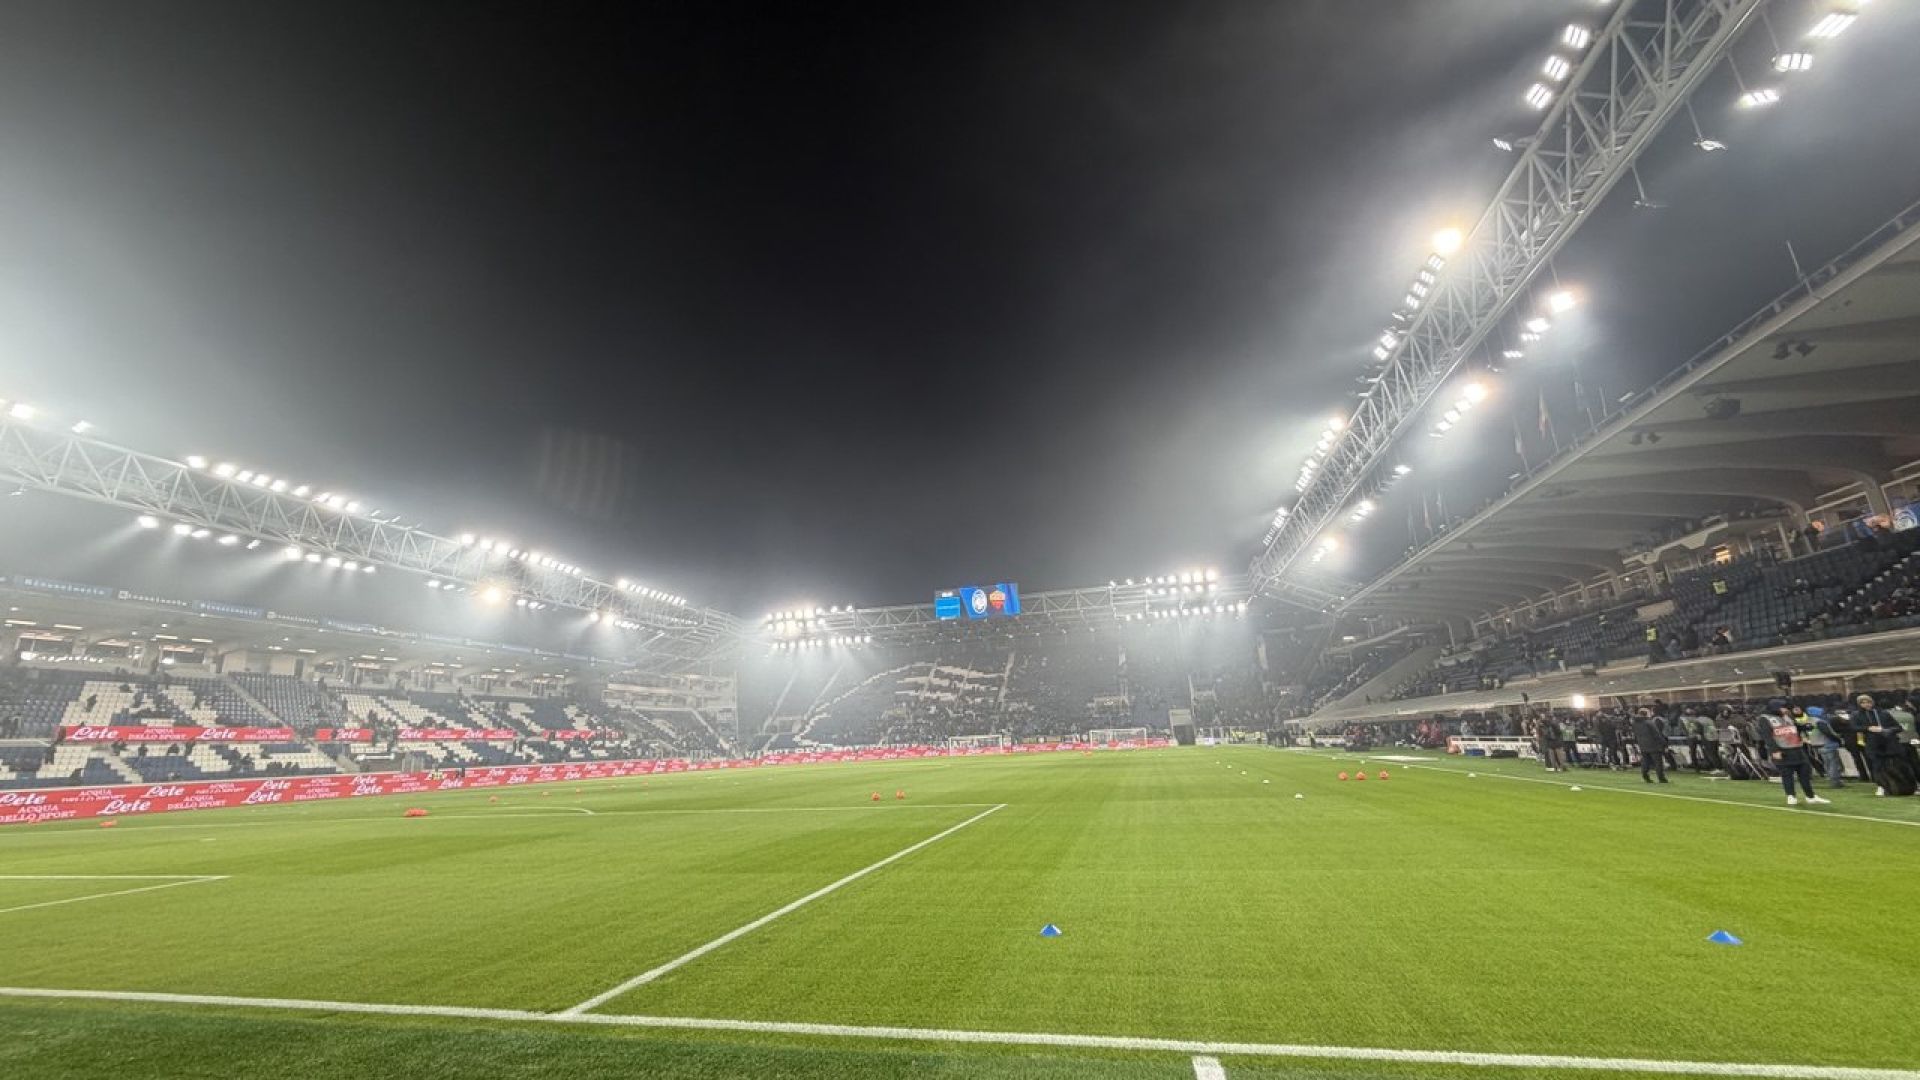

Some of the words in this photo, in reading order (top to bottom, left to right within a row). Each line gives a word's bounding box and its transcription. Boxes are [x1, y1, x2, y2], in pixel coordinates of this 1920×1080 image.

[66, 727, 118, 740] Lete
[197, 728, 237, 740] Lete
[140, 786, 185, 799] Lete
[240, 790, 282, 805] Lete
[18, 804, 58, 814] ACQUA
[96, 800, 151, 814] Lete
